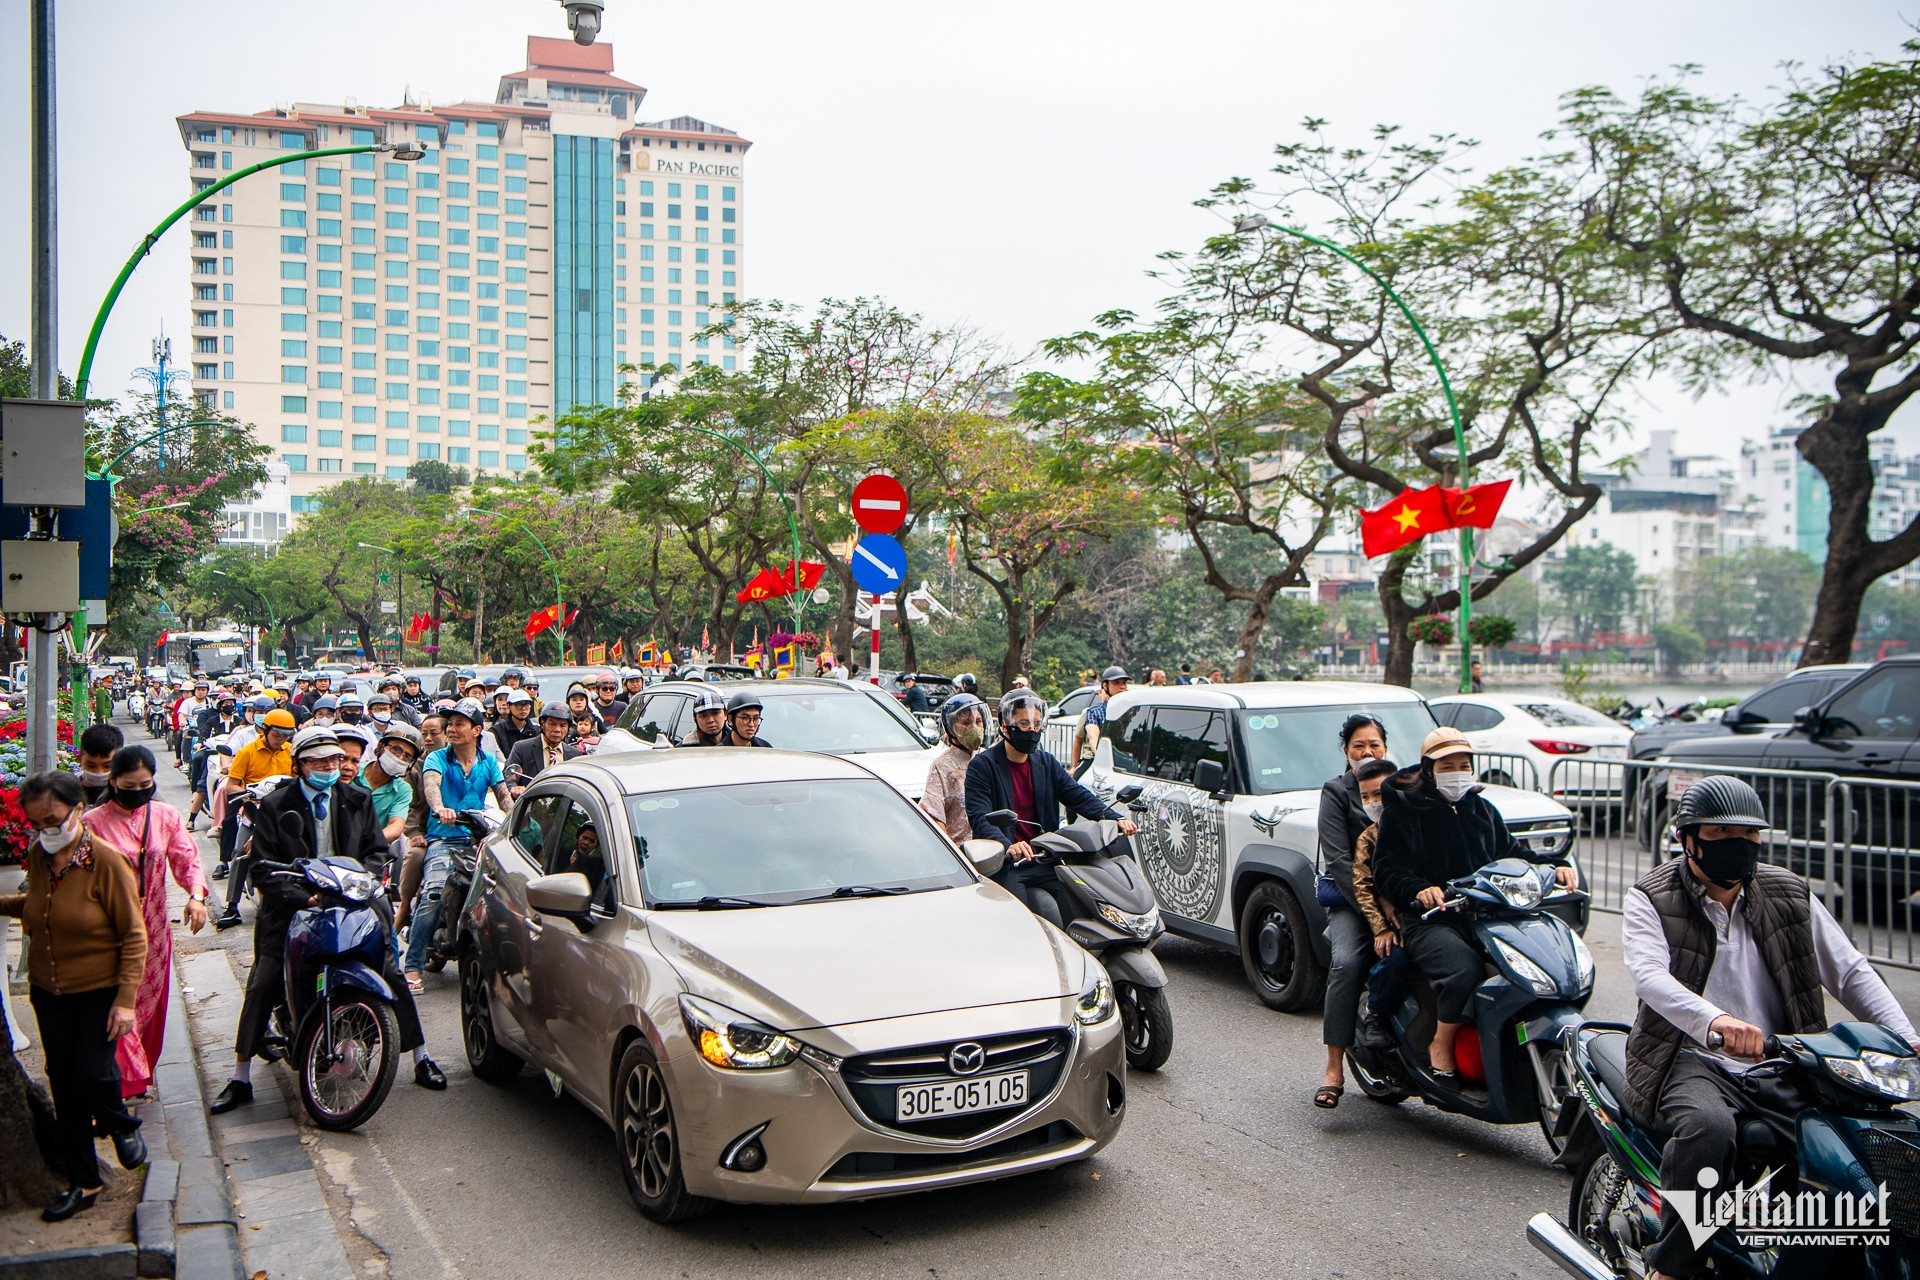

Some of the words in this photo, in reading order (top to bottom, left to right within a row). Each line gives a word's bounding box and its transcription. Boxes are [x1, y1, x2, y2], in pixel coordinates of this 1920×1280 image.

[657, 159, 683, 172] PAN
[689, 161, 739, 177] PACIFIC
[902, 1074, 1024, 1116] 30E-051.05
